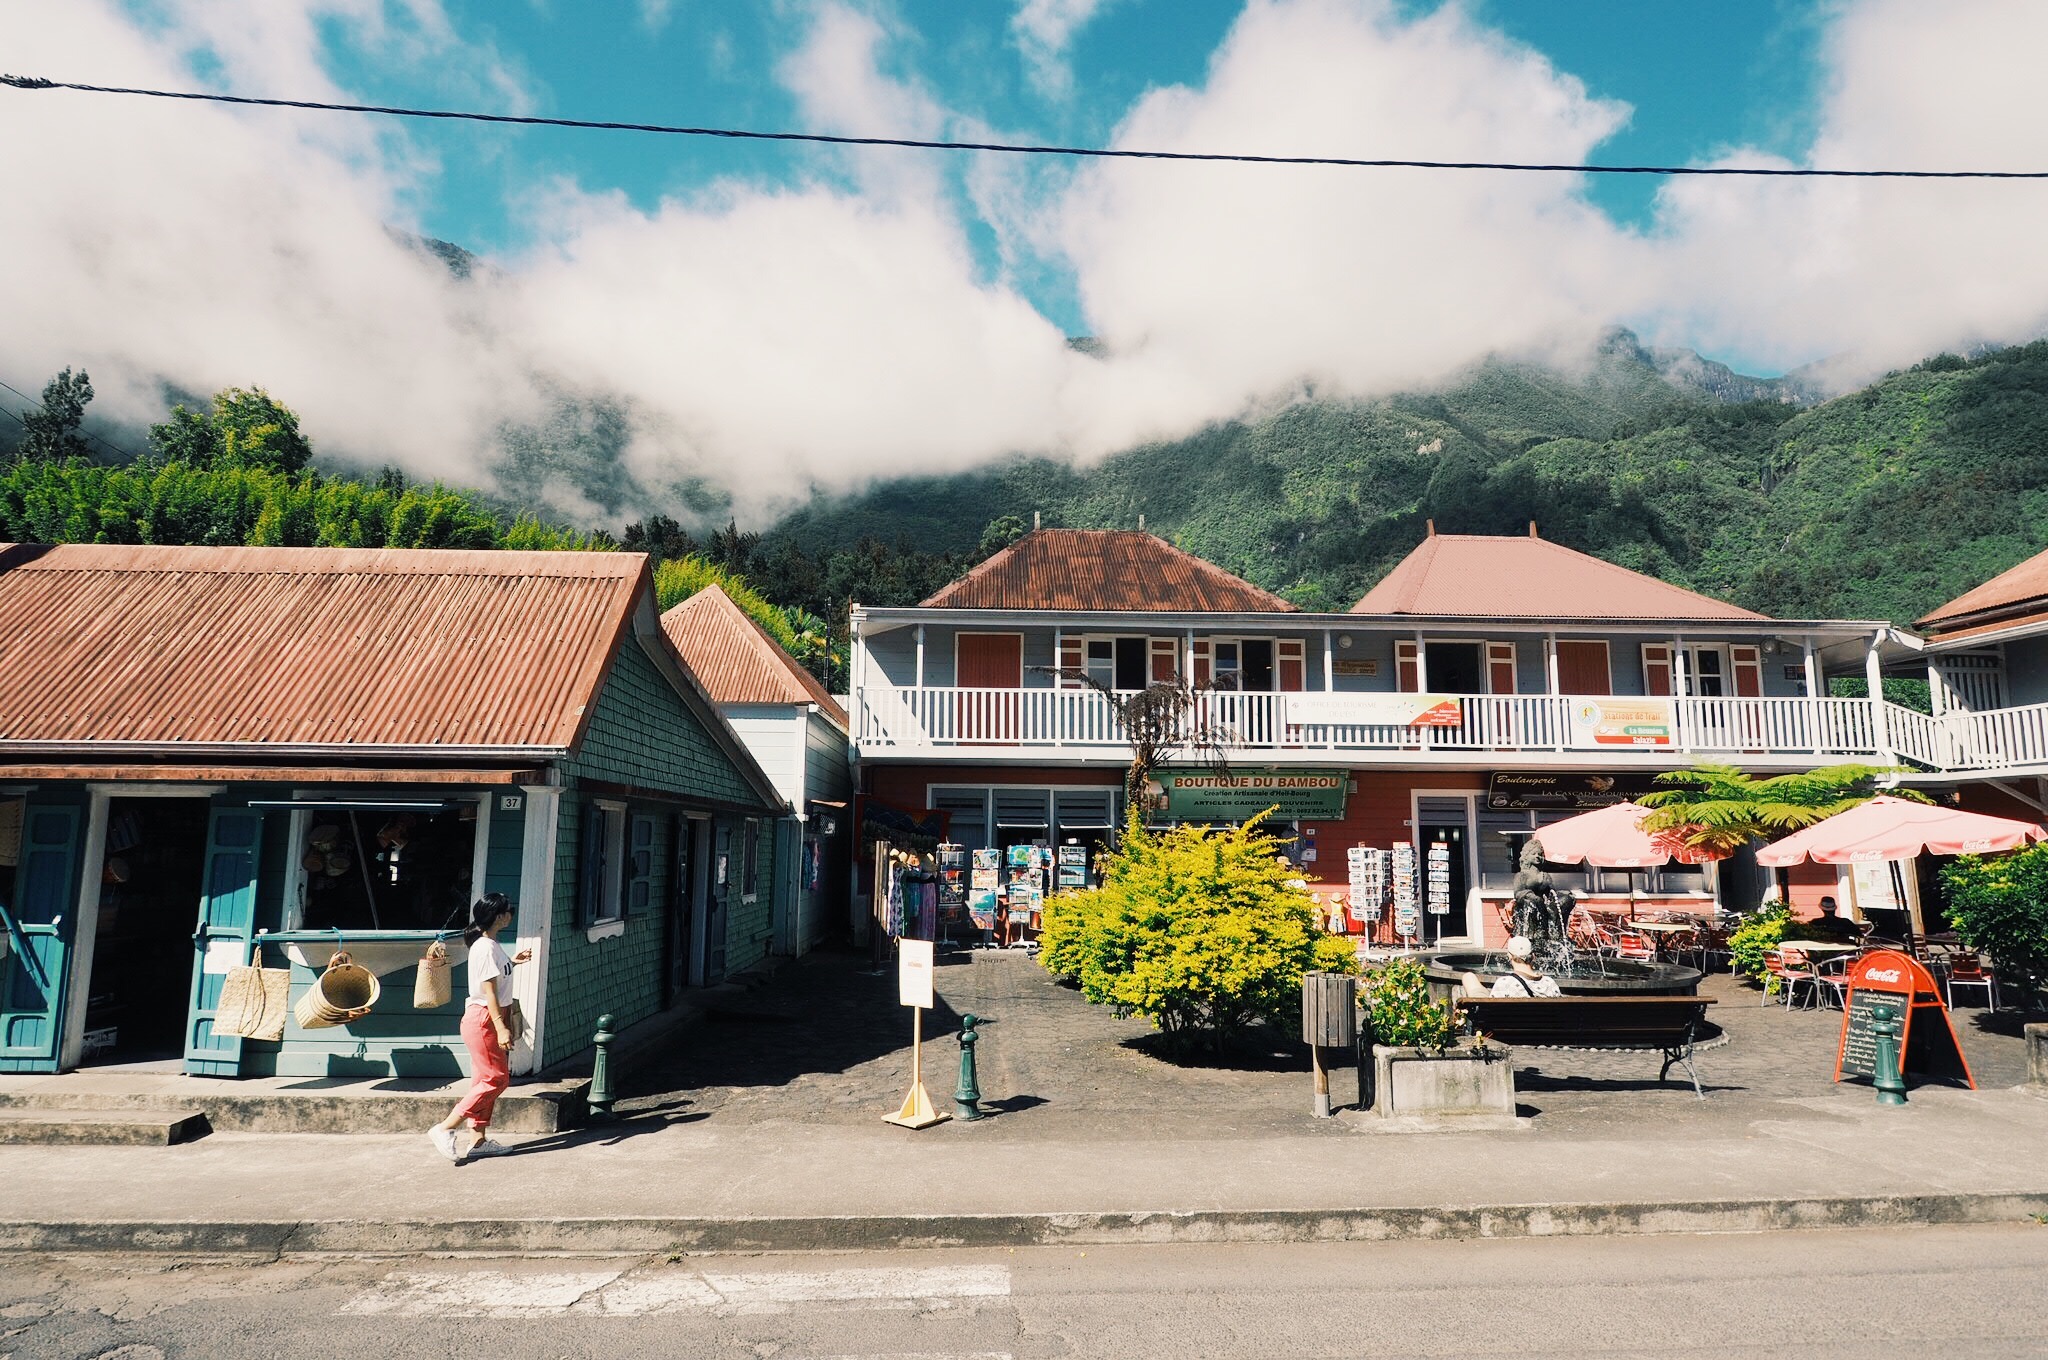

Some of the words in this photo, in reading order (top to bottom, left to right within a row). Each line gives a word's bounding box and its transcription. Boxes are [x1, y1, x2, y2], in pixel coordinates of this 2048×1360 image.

[1604, 711, 1633, 720] Stations
[1635, 711, 1644, 720] de
[1645, 711, 1661, 720] Trail
[1629, 727, 1637, 735] La
[1632, 736, 1657, 744] Salazie
[1174, 777, 1249, 788] BOUTIQUE
[1253, 777, 1273, 788] DU
[1277, 777, 1339, 788] BAMBOU
[1496, 775, 1557, 785] Boulangerie
[506, 798, 518, 808] 37
[1962, 838, 1992, 851] Coca-Cola
[1849, 850, 1884, 862] Coca-Cola
[1615, 858, 1641, 867] Coca-Cola
[1865, 967, 1901, 983] Coca-Cola
